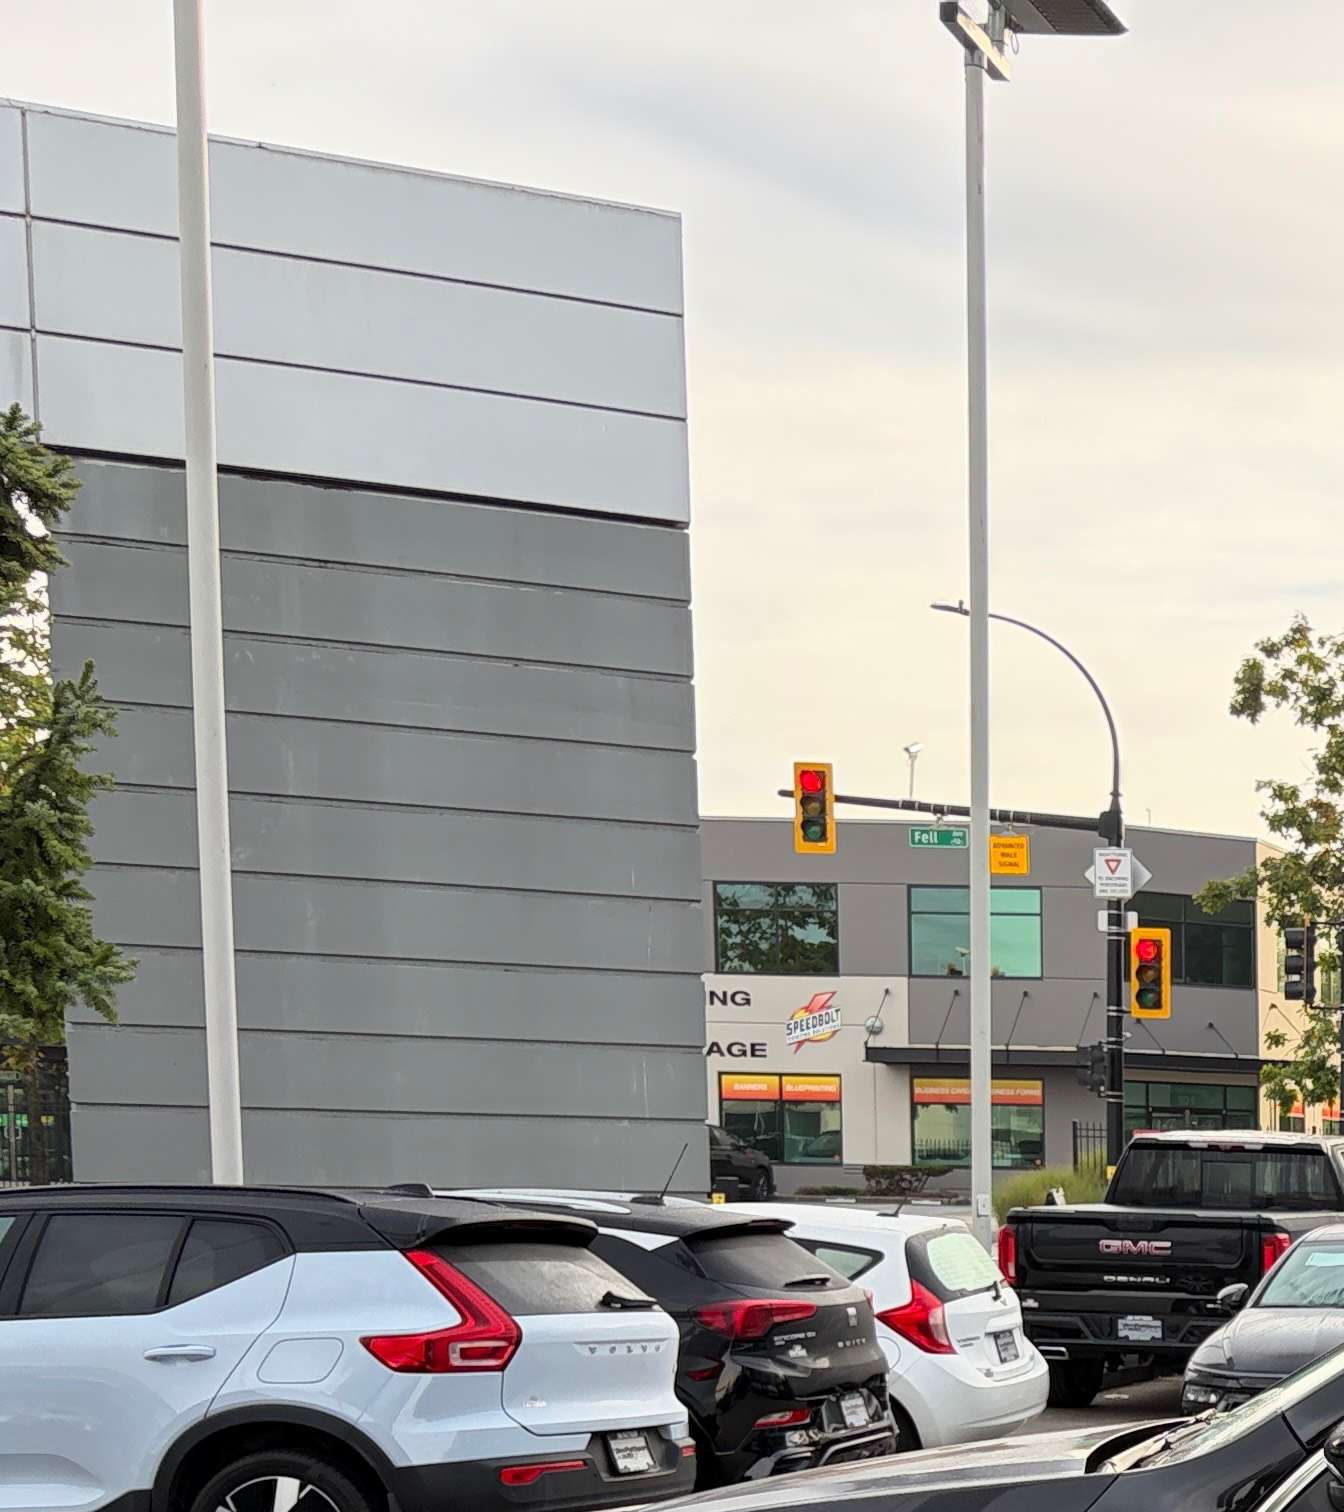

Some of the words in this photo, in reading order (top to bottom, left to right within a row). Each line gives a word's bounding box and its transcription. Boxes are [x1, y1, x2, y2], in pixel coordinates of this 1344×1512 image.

[914, 831, 938, 844] Fell
[786, 1008, 841, 1036] SPEEDBOLT
[1099, 1239, 1172, 1256] GMC
[1103, 1275, 1171, 1284] DENALI
[588, 1345, 661, 1355] VOLVO
